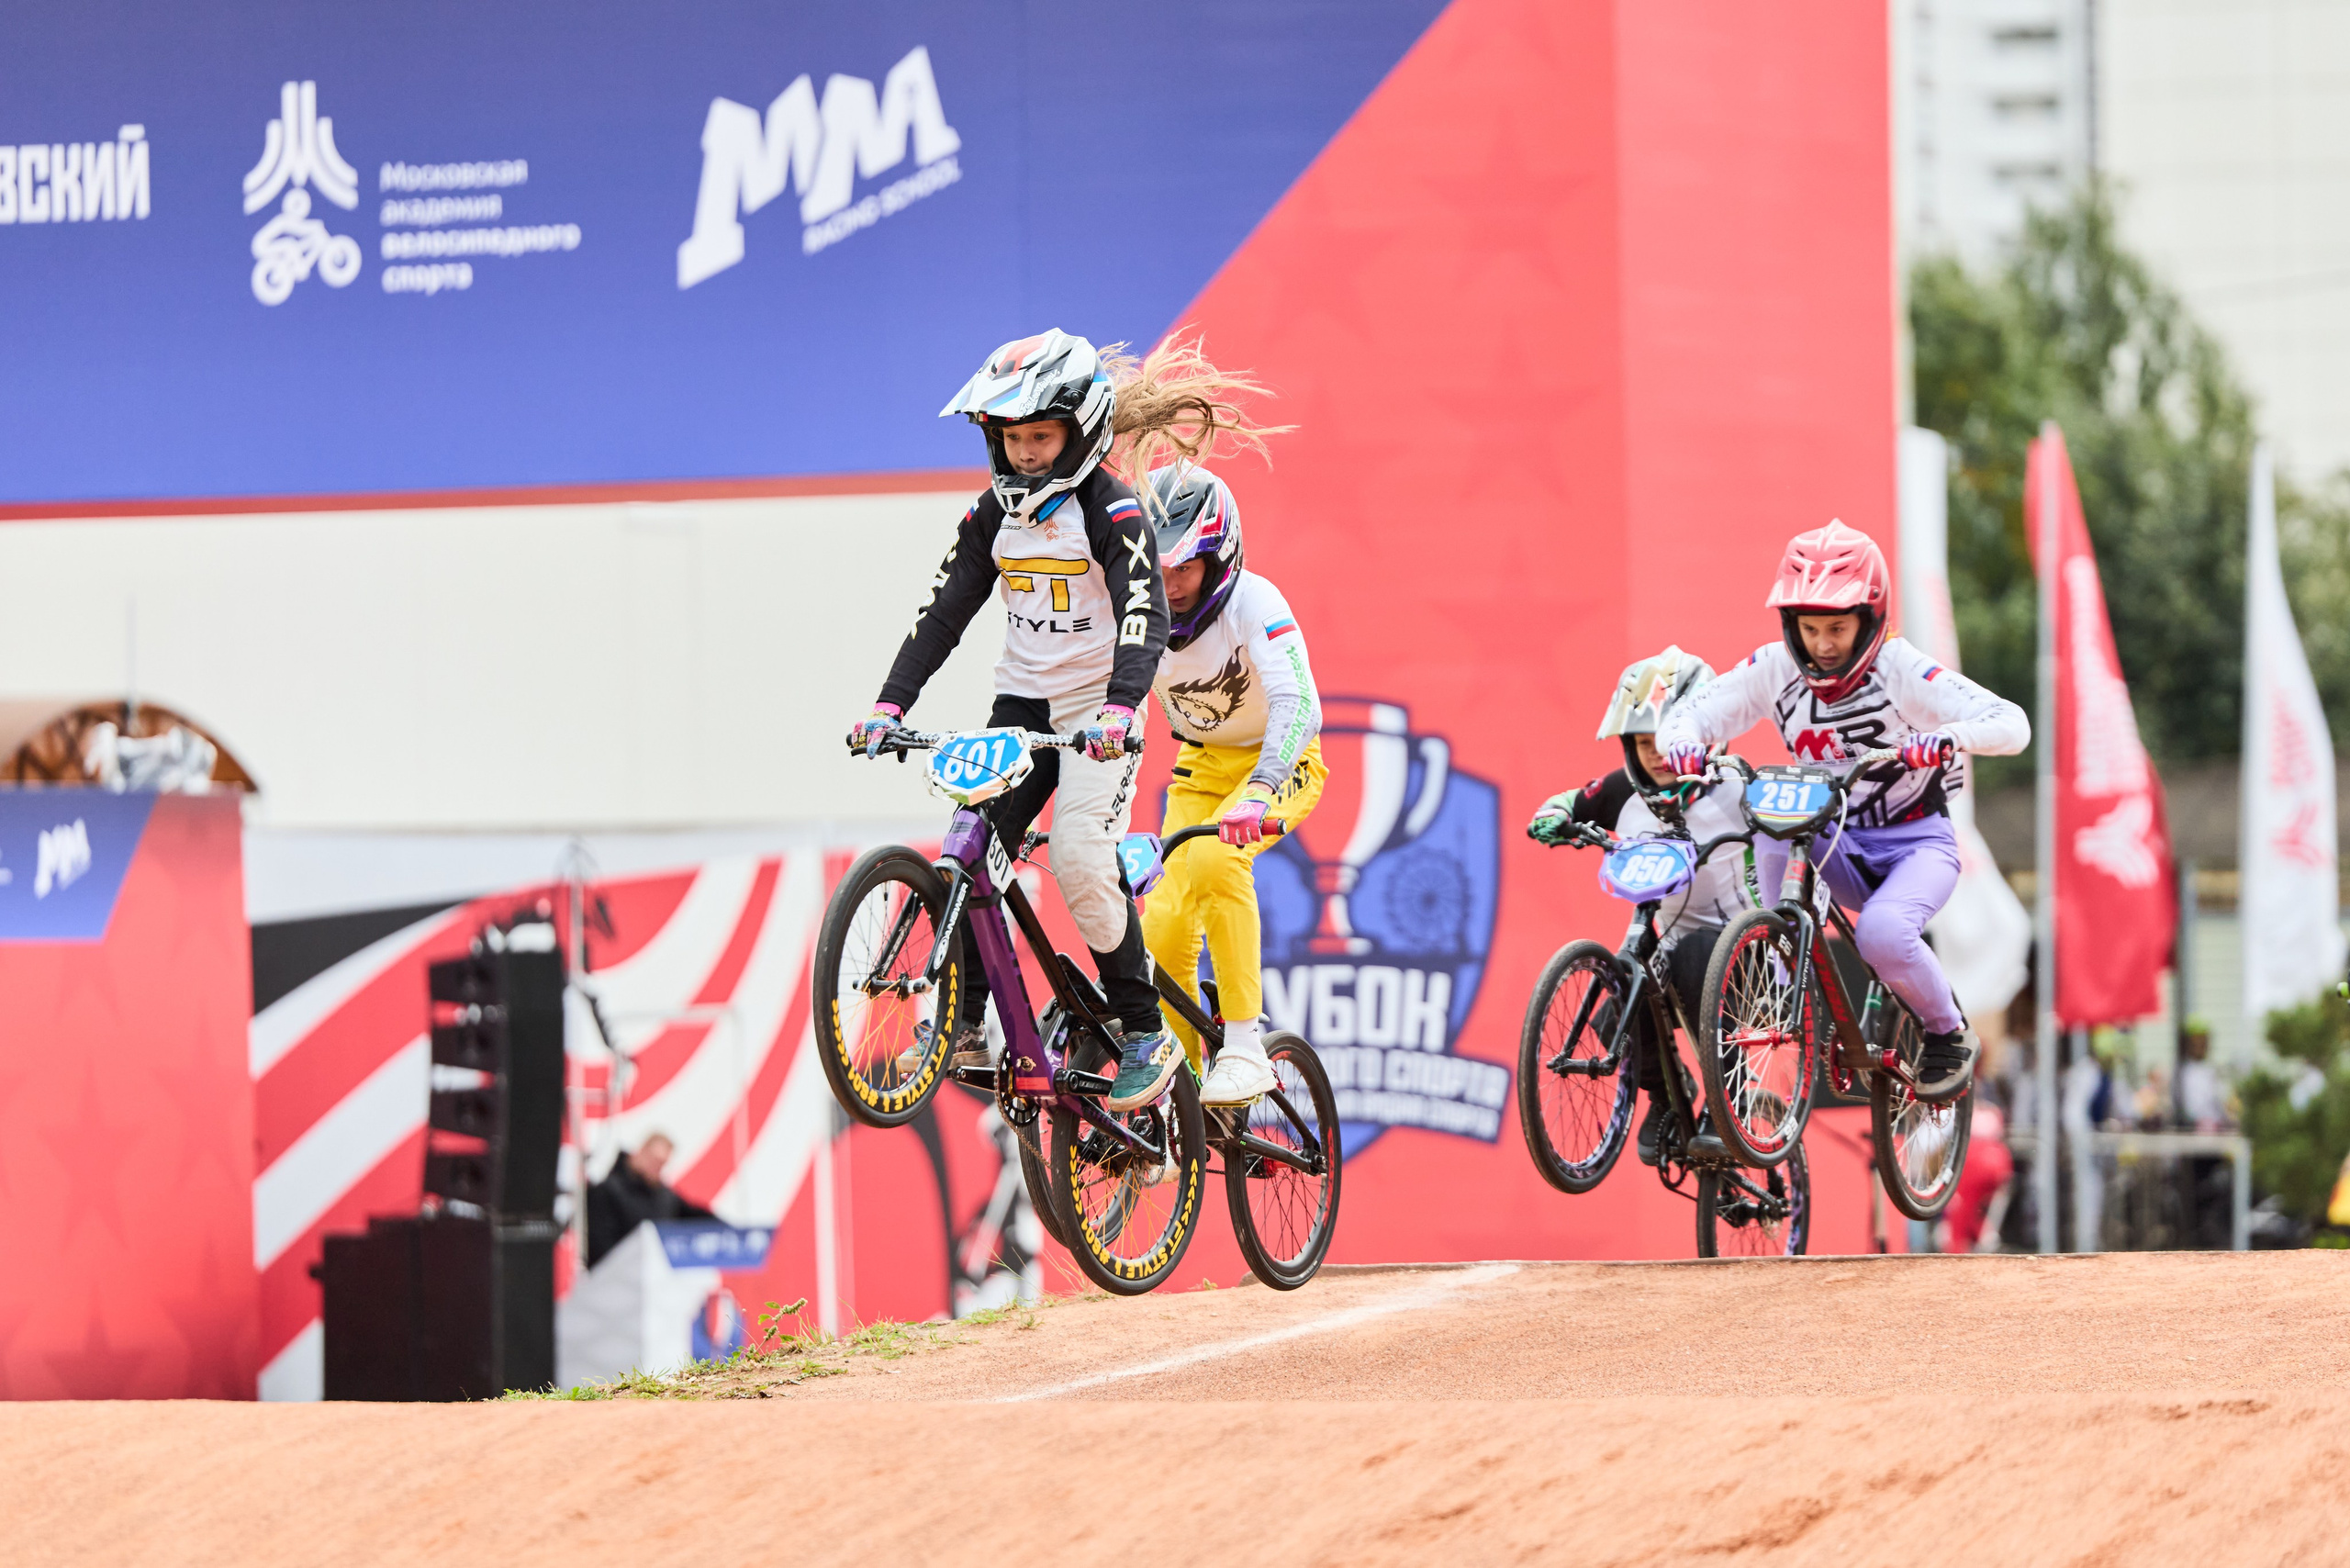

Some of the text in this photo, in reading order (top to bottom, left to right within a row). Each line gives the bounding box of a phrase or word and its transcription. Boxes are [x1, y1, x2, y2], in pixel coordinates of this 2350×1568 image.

[379, 159, 529, 193] Московская
[379, 194, 503, 228] академия
[380, 222, 582, 261] велосипедного
[381, 262, 474, 297] спорта
[1119, 528, 1152, 646] BMX
[943, 738, 1007, 782] 601
[1758, 781, 1812, 812] 251
[989, 835, 1011, 882] 601
[1618, 854, 1676, 884] 850
[944, 881, 968, 941] ANSWER
[1260, 964, 1452, 1054] УБОК
[893, 1065, 934, 1112] STYLE
[1125, 1247, 1169, 1279] STYLE
